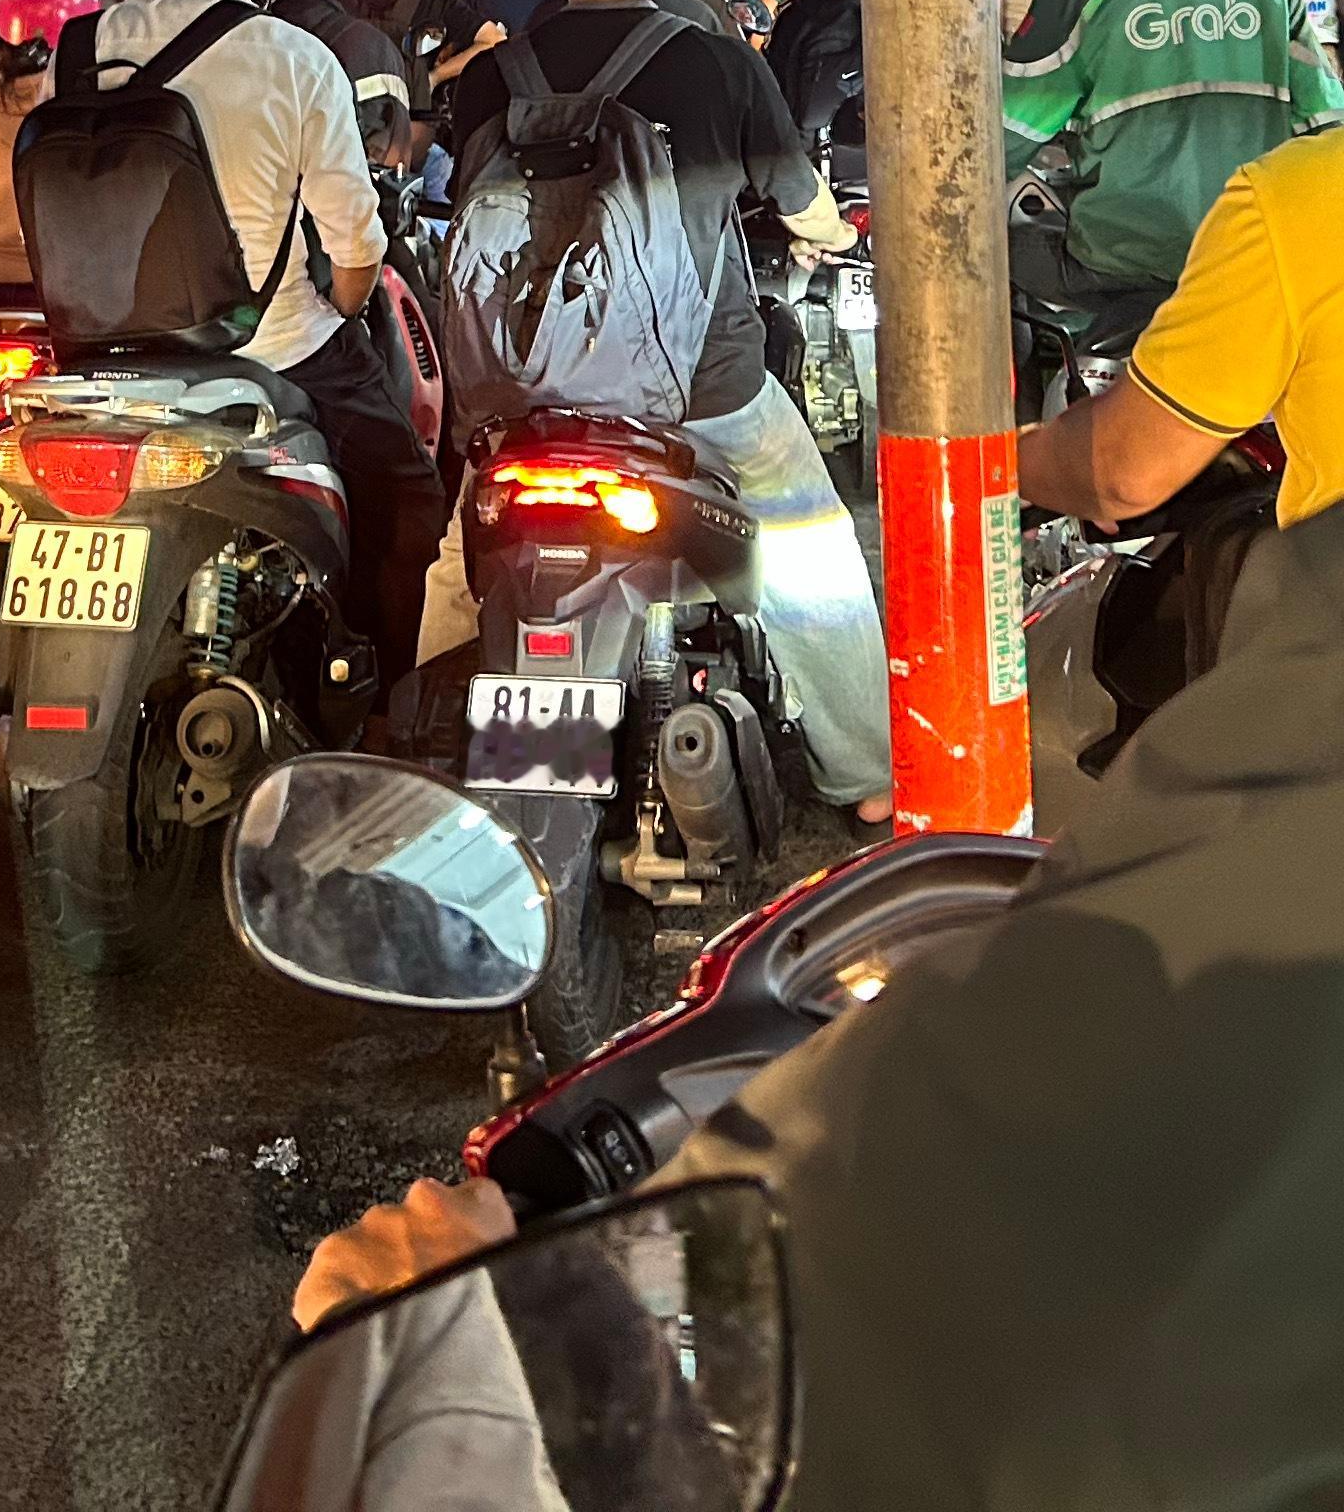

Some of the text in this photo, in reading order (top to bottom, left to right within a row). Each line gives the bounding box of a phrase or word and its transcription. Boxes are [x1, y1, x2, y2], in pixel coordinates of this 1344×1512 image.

[30, 528, 126, 573] 47-B1
[538, 547, 588, 560] HONDA
[8, 576, 133, 623] 618.68
